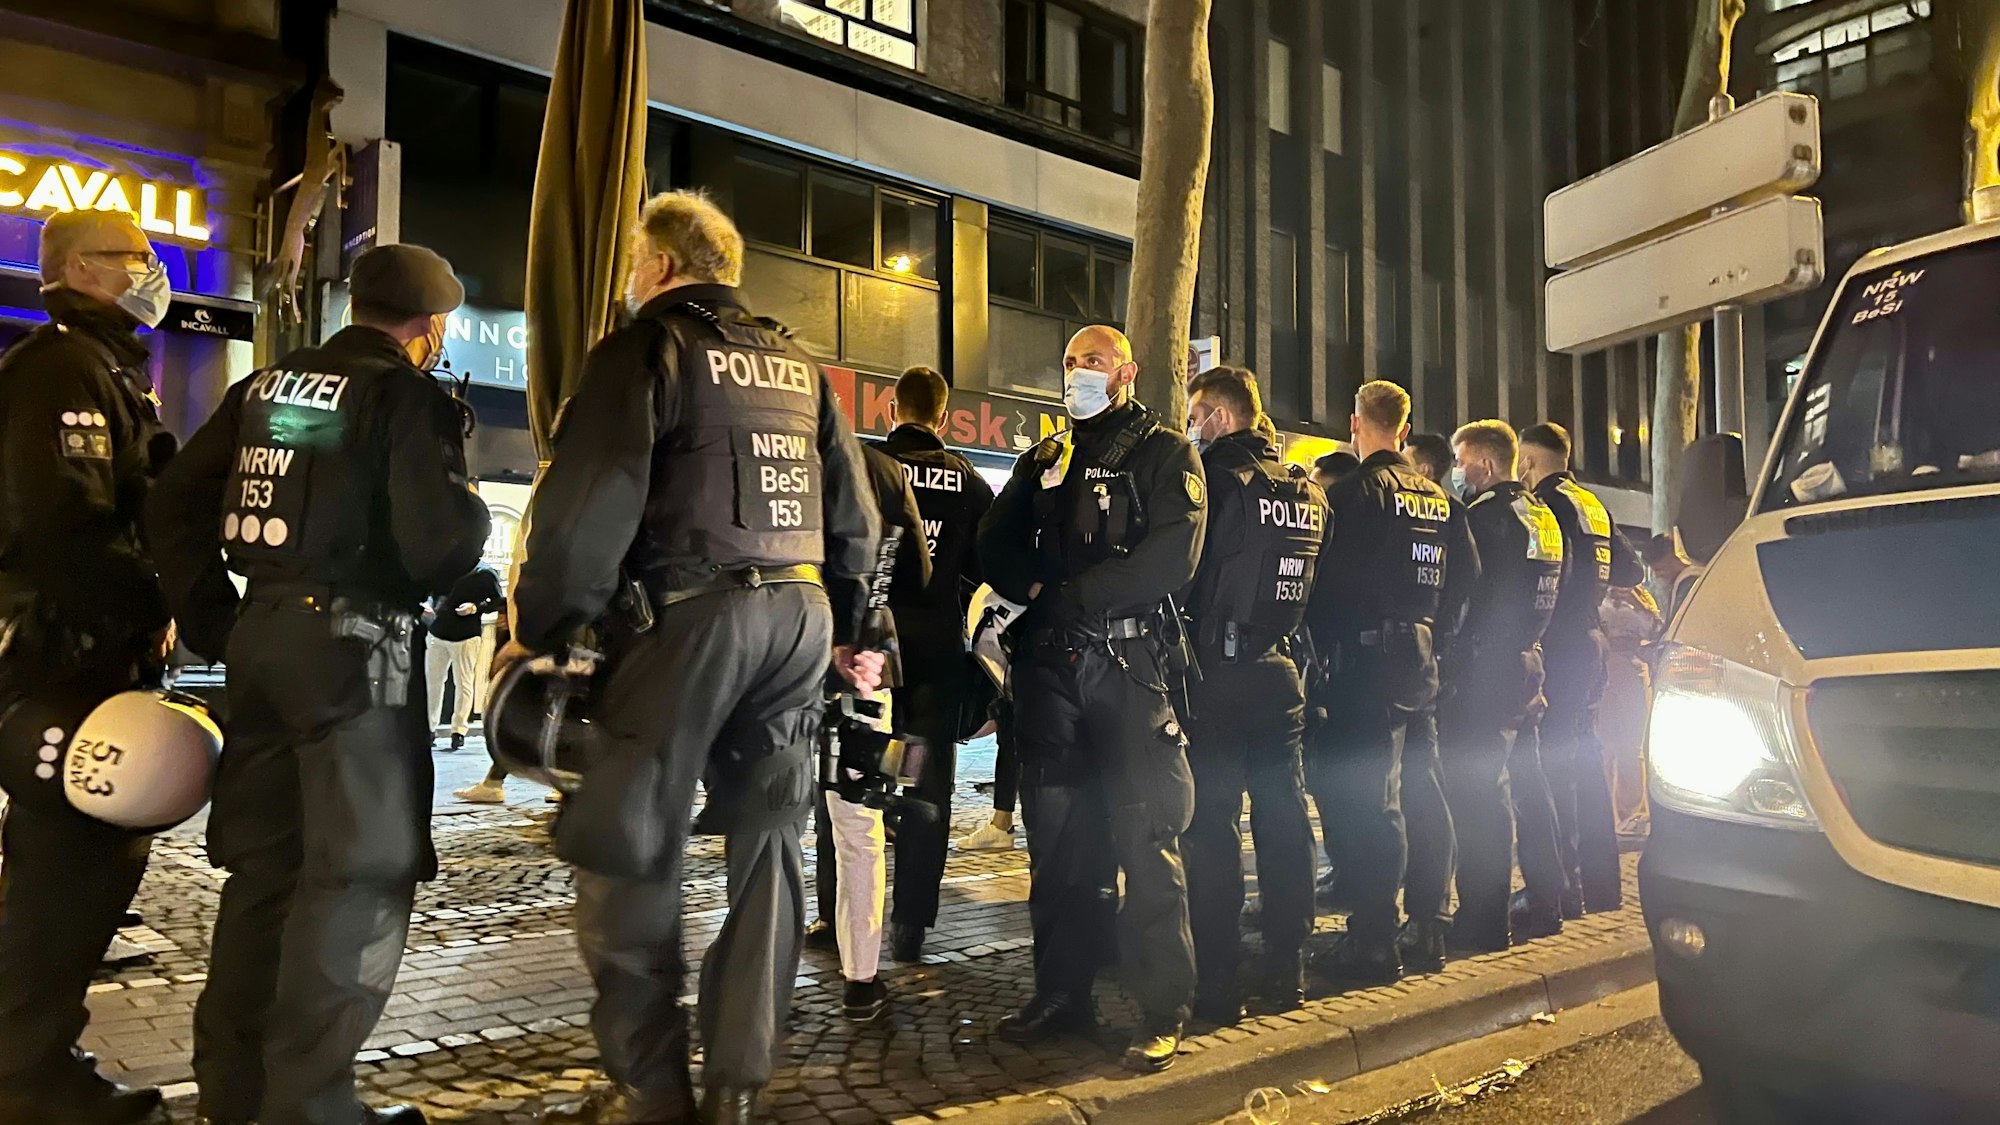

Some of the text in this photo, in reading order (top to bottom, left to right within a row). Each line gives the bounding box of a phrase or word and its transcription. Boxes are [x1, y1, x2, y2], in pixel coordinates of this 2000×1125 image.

[0, 156, 210, 241] CAVALL
[1862, 270, 1925, 298] NRW
[1874, 290, 1898, 306] 15
[181, 320, 229, 335] INCAVALL
[706, 349, 812, 396] POLIZEI
[246, 369, 349, 412] POLIZEI
[862, 381, 1008, 449] Ksk
[752, 432, 806, 460] NRW
[238, 446, 294, 477] NRW
[761, 465, 810, 493] BeSi
[902, 463, 962, 492] OLIZEI
[241, 480, 273, 508] 153
[1394, 493, 1451, 522] POLIZEI
[769, 500, 802, 527] 153
[1259, 498, 1322, 532] POLIZEI
[1278, 557, 1304, 577] NRW
[1412, 542, 1442, 564] NRW
[1417, 567, 1440, 586] 1533
[1275, 581, 1304, 602] 1533
[70, 739, 92, 791] NRW
